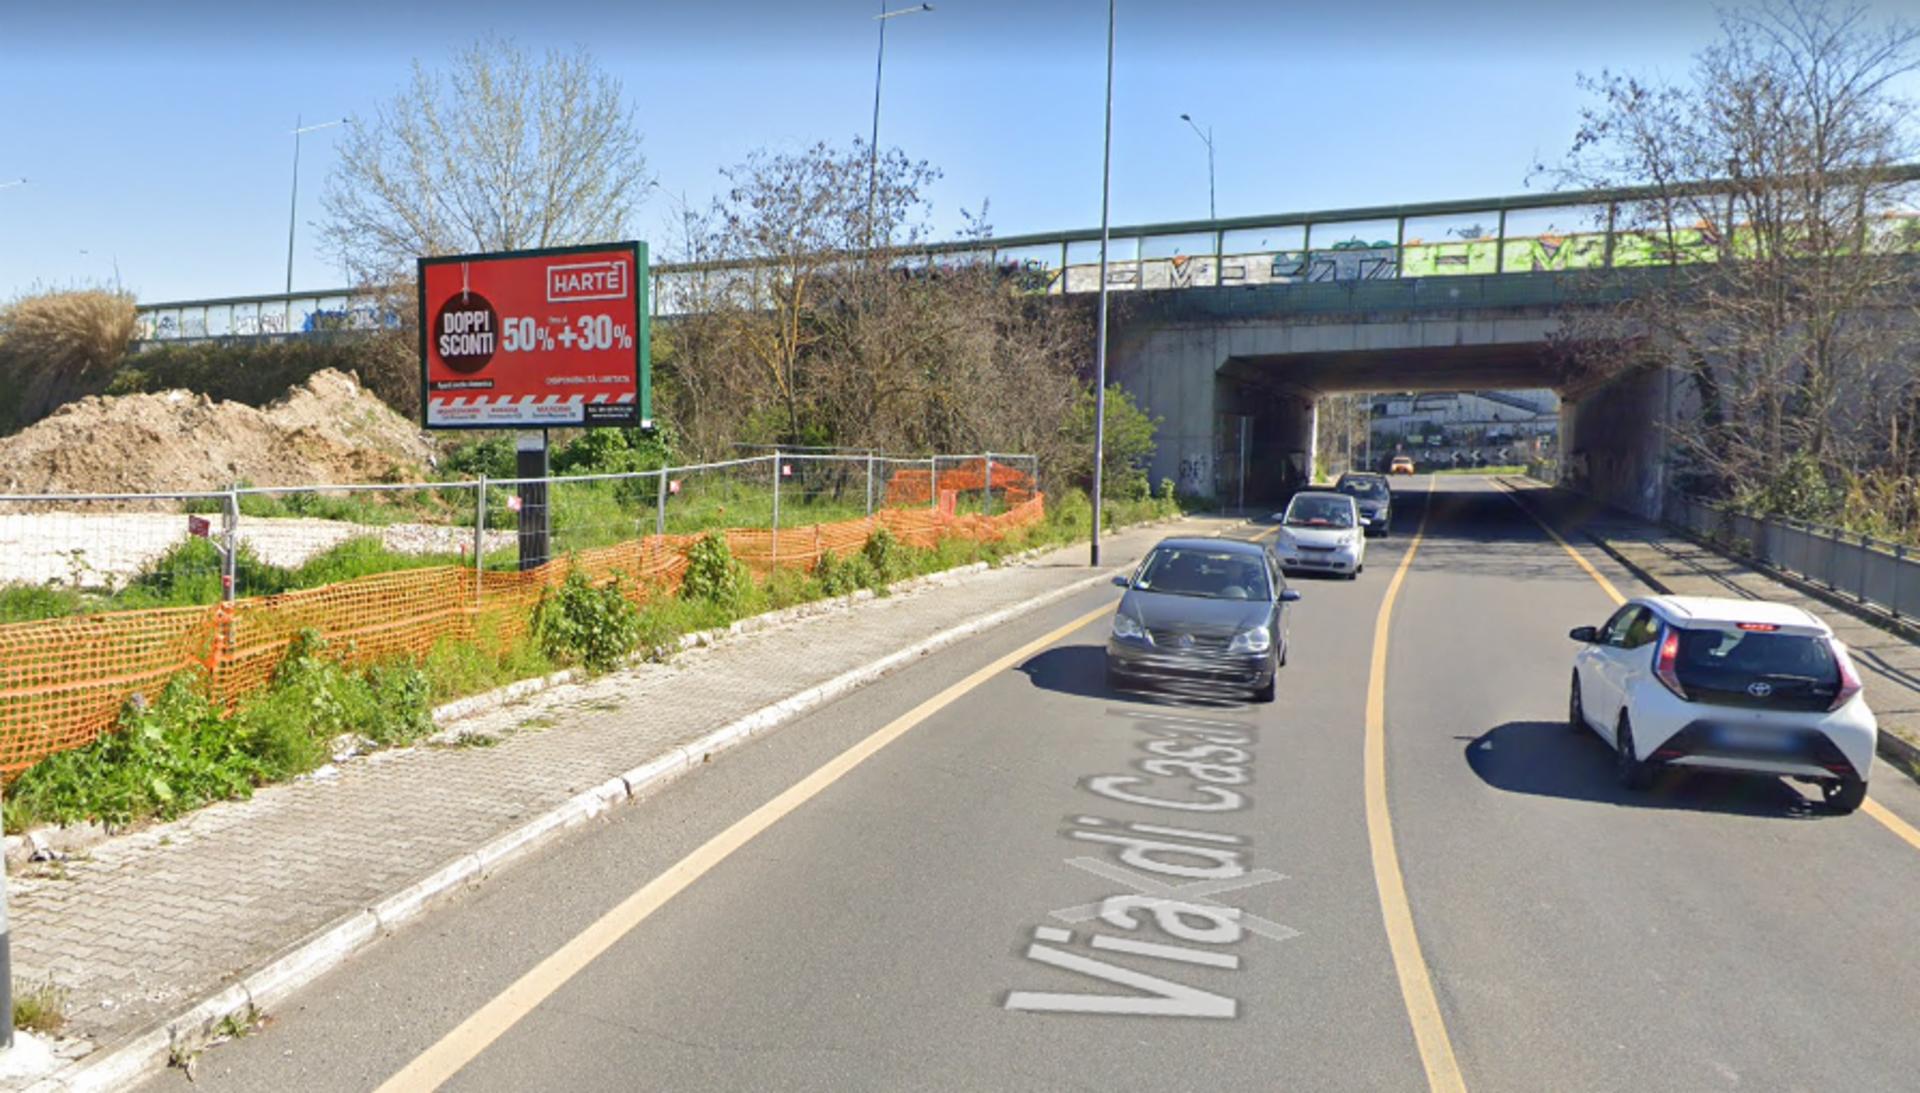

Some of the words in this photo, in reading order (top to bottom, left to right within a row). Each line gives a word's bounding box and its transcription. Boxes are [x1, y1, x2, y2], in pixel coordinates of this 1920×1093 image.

[443, 310, 490, 333] DOPPI
[503, 316, 555, 352] 50%
[439, 331, 494, 357] SCONTI
